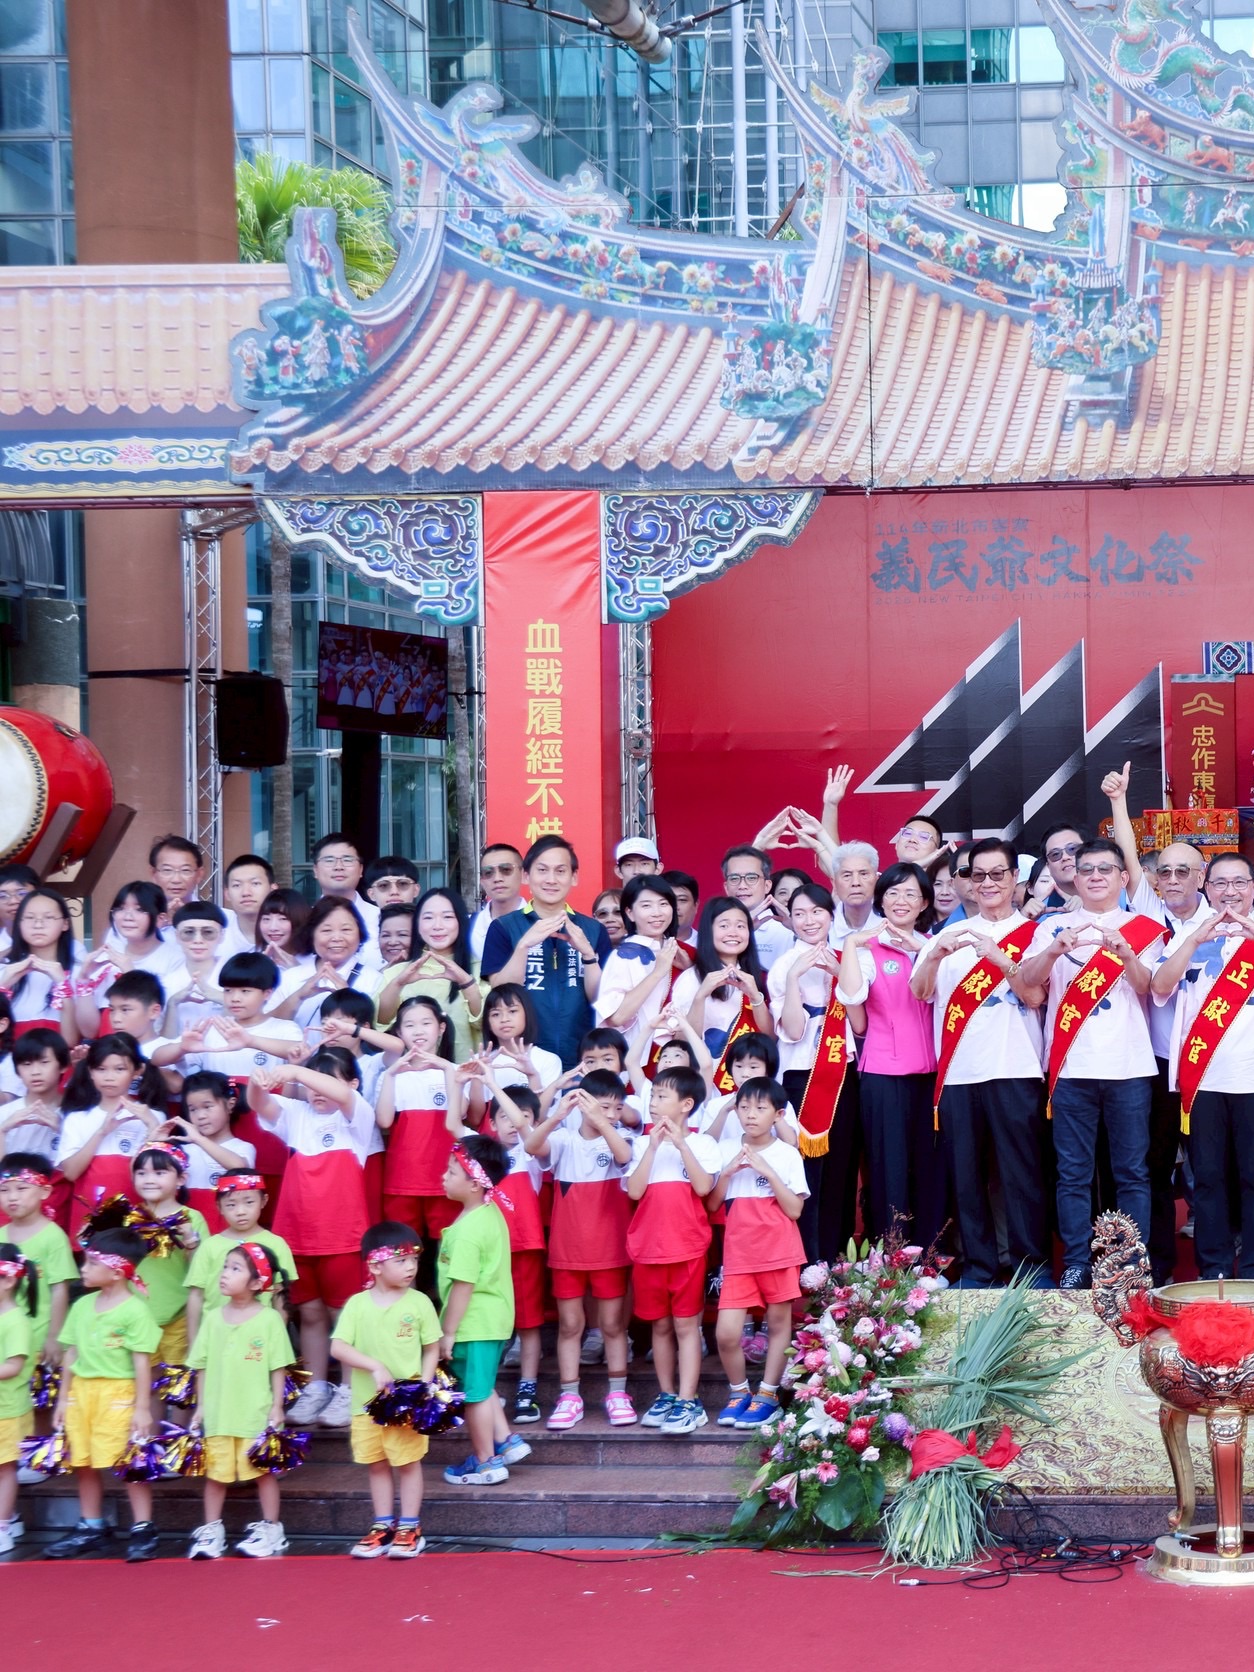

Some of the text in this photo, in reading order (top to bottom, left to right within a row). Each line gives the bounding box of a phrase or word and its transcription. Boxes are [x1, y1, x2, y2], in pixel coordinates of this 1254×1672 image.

[870, 530, 1204, 593] 義民爺文化祭
[918, 594, 950, 603] NEW
